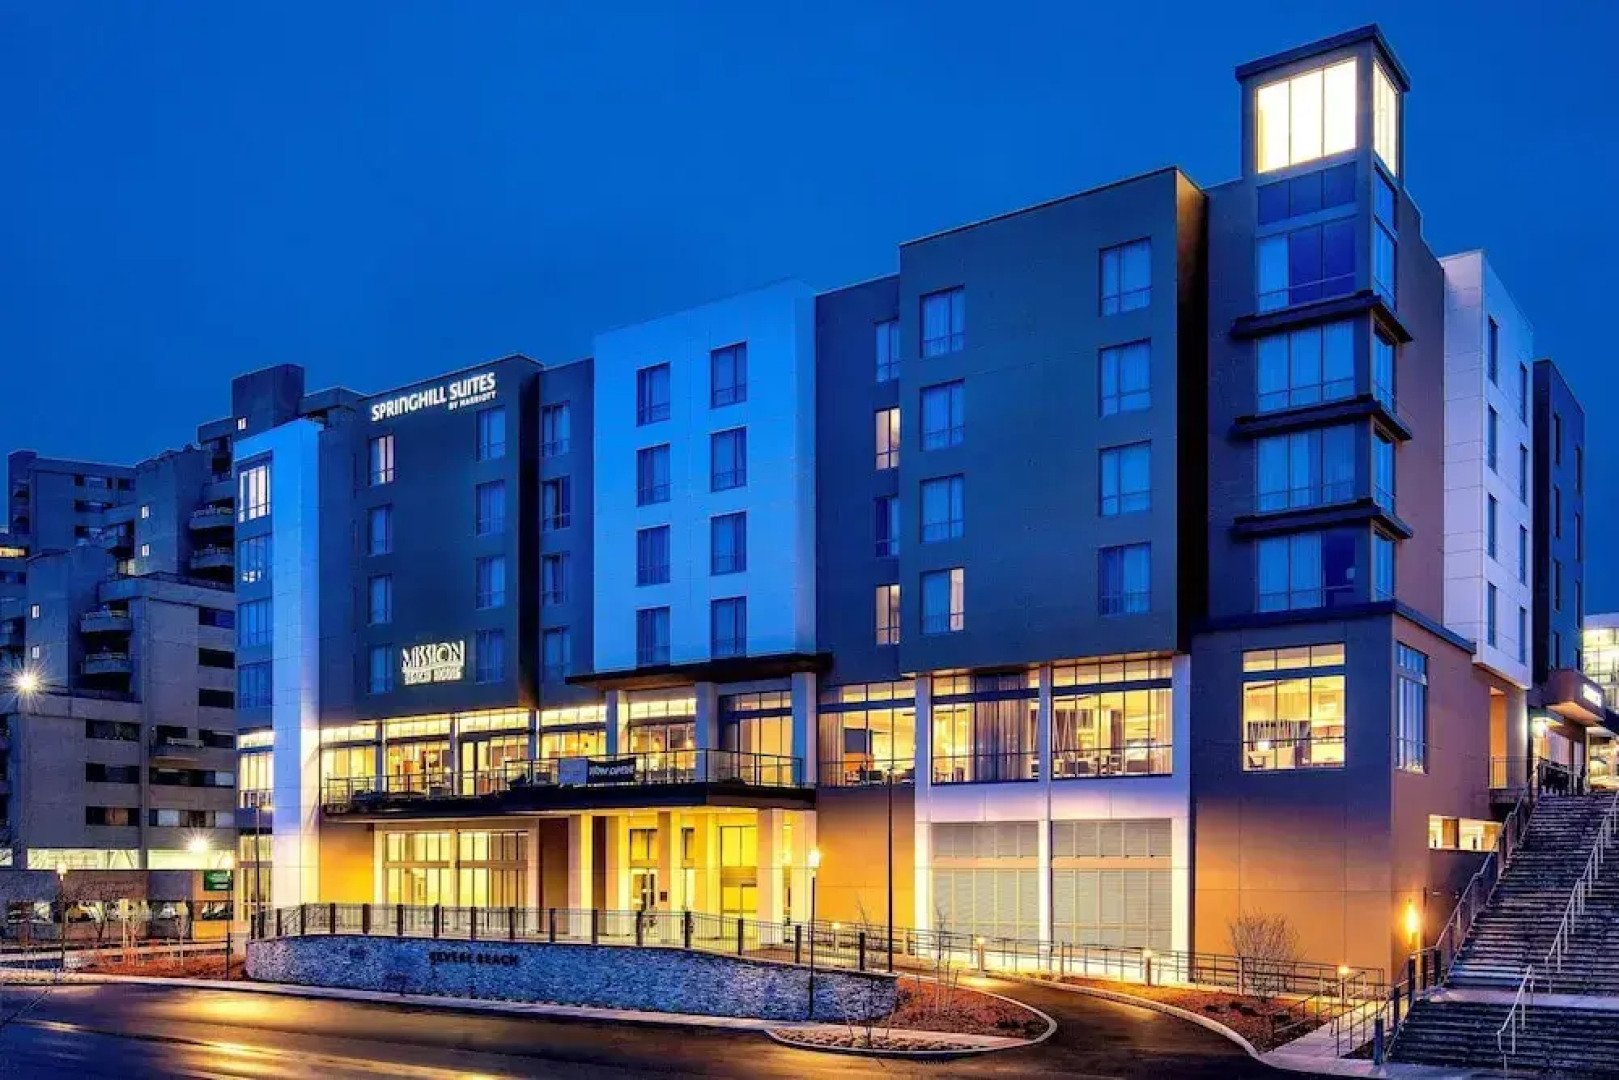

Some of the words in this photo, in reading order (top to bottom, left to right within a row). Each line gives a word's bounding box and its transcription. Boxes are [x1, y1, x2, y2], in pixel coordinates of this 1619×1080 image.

[371, 386, 447, 421] SPRINGHILL
[449, 372, 496, 400] SUITES
[402, 640, 465, 672] MISSION
[477, 953, 519, 966] BEACH
